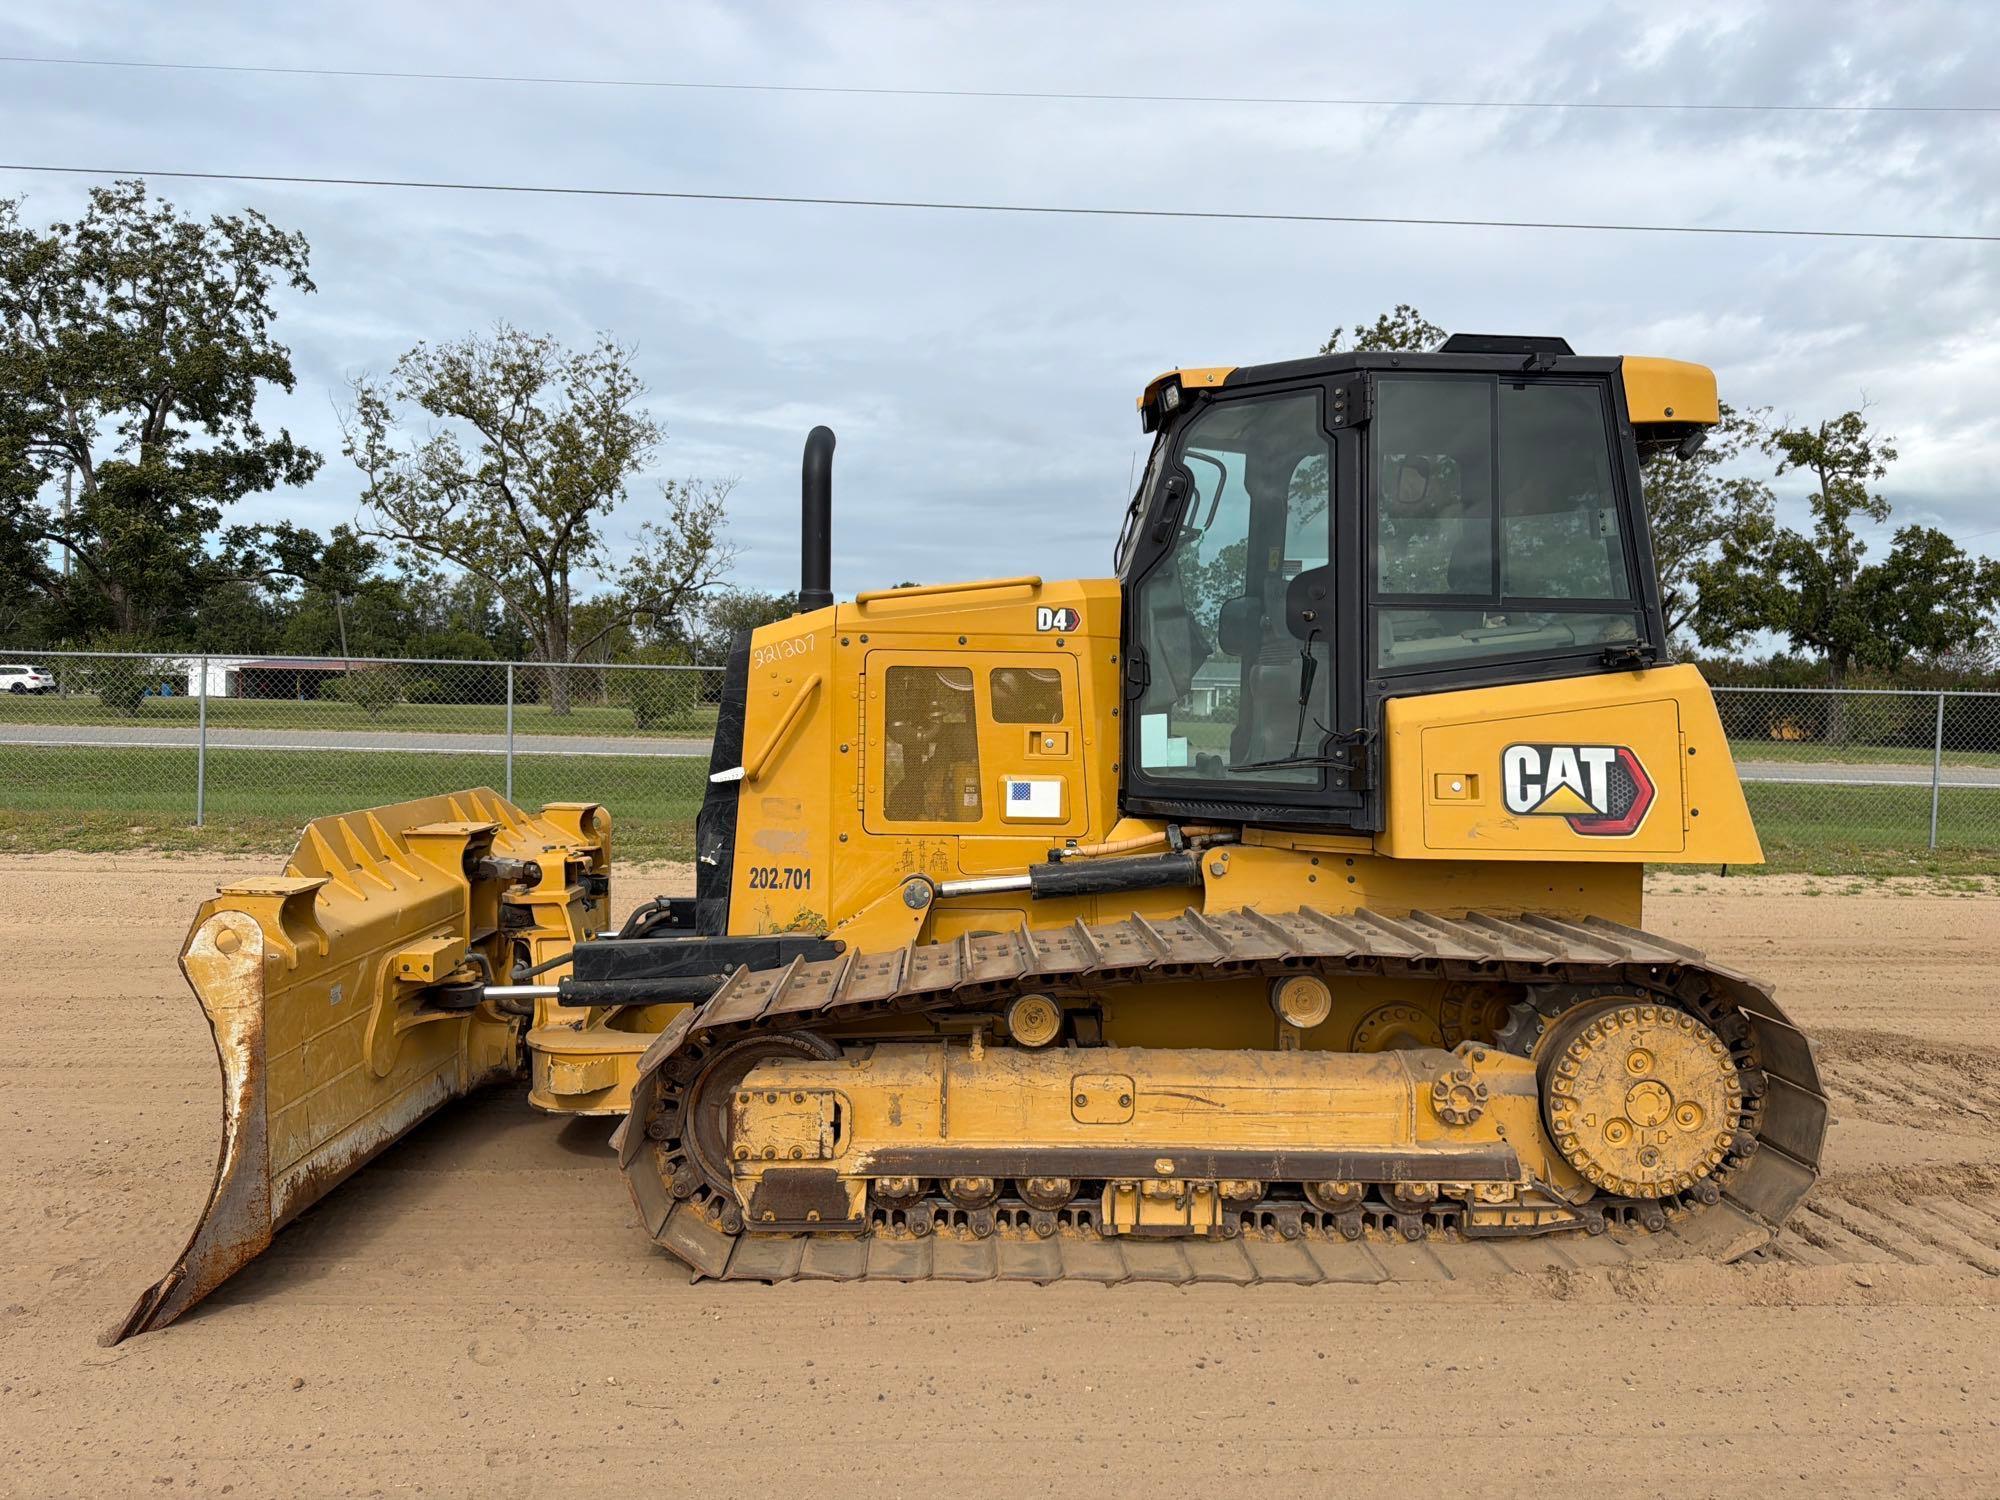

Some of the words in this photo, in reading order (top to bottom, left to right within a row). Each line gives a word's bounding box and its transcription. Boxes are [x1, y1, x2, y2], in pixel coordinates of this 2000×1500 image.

[1038, 607, 1067, 631] D4
[1504, 745, 1616, 814] CAT
[749, 867, 811, 890] 202.701
